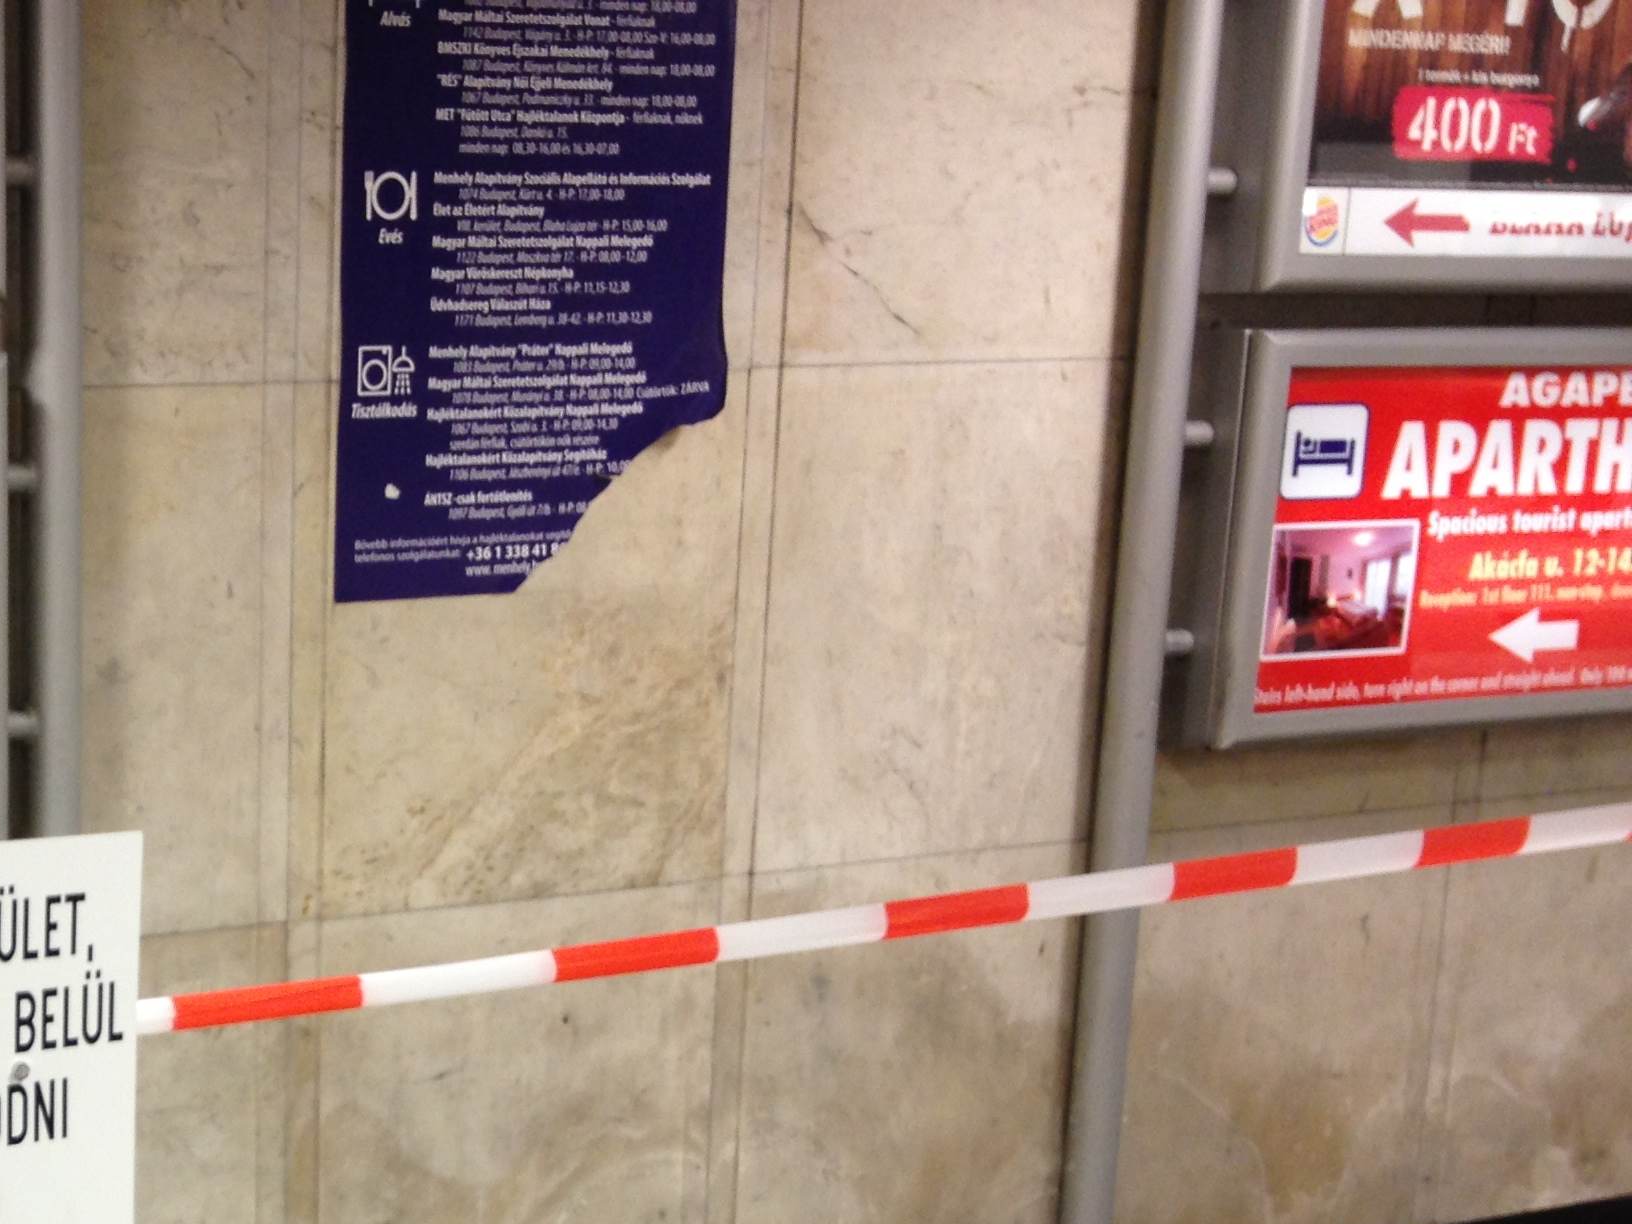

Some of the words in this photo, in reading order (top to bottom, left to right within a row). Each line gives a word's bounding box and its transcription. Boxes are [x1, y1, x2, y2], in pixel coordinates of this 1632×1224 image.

[438, 9, 472, 24] Magyar
[1409, 96, 1501, 154] 400
[1508, 122, 1537, 155] Ft
[433, 171, 473, 185] Menhely
[475, 172, 523, 187] Alapítvány
[671, 173, 711, 188] Szolgálat
[496, 203, 545, 219] Alapítvány
[432, 235, 466, 250] Magyar
[431, 267, 466, 282] Magyar
[429, 345, 468, 359] Menhely
[469, 345, 517, 359] Alapítvány
[428, 377, 462, 392] Magyar
[1428, 506, 1508, 542] Spacious
[1512, 504, 1576, 534] tourist
[466, 546, 491, 561] +36
[495, 546, 501, 559] 1
[505, 544, 528, 559] 338
[532, 543, 547, 557] 41
[13, 969, 124, 1054] BELÜL
